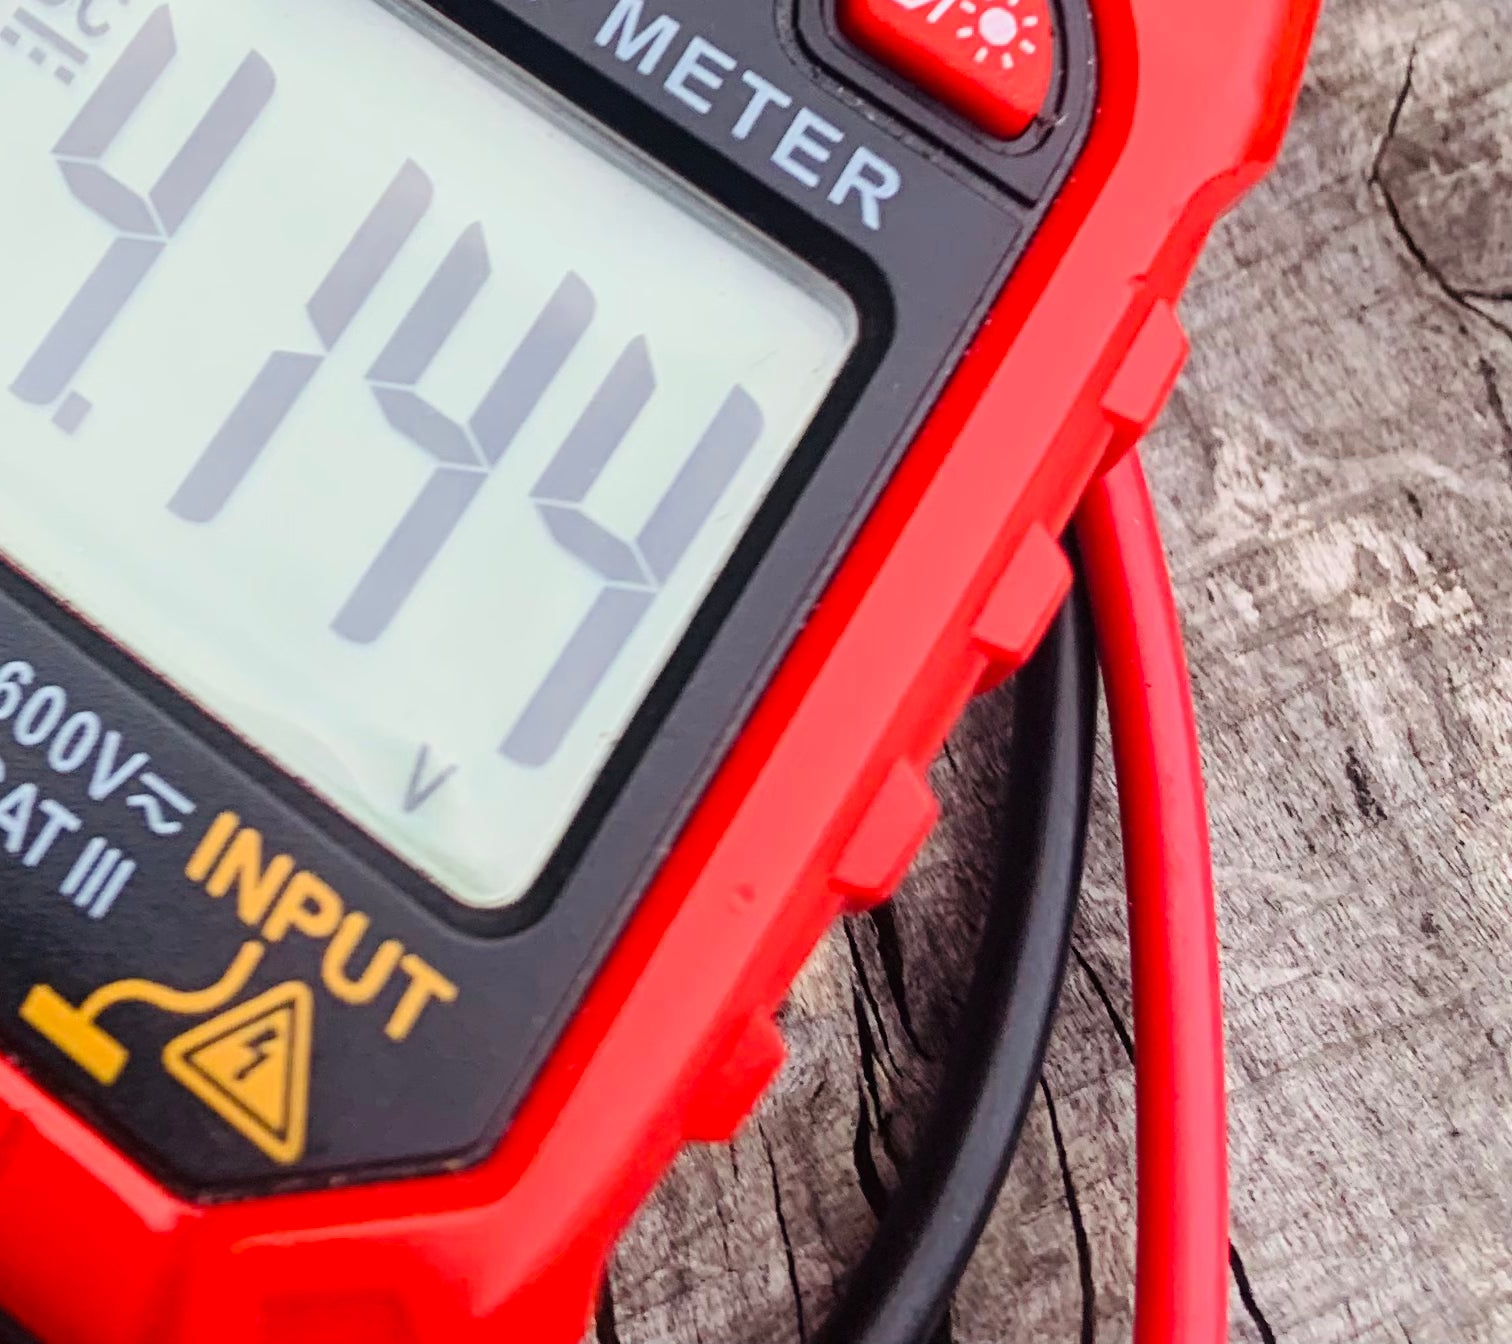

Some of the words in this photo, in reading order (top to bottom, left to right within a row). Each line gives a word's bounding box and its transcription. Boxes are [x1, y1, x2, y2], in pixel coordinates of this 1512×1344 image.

[402, 742, 459, 815] V
[58, 835, 138, 919] III
[185, 810, 459, 1041] INPUT
